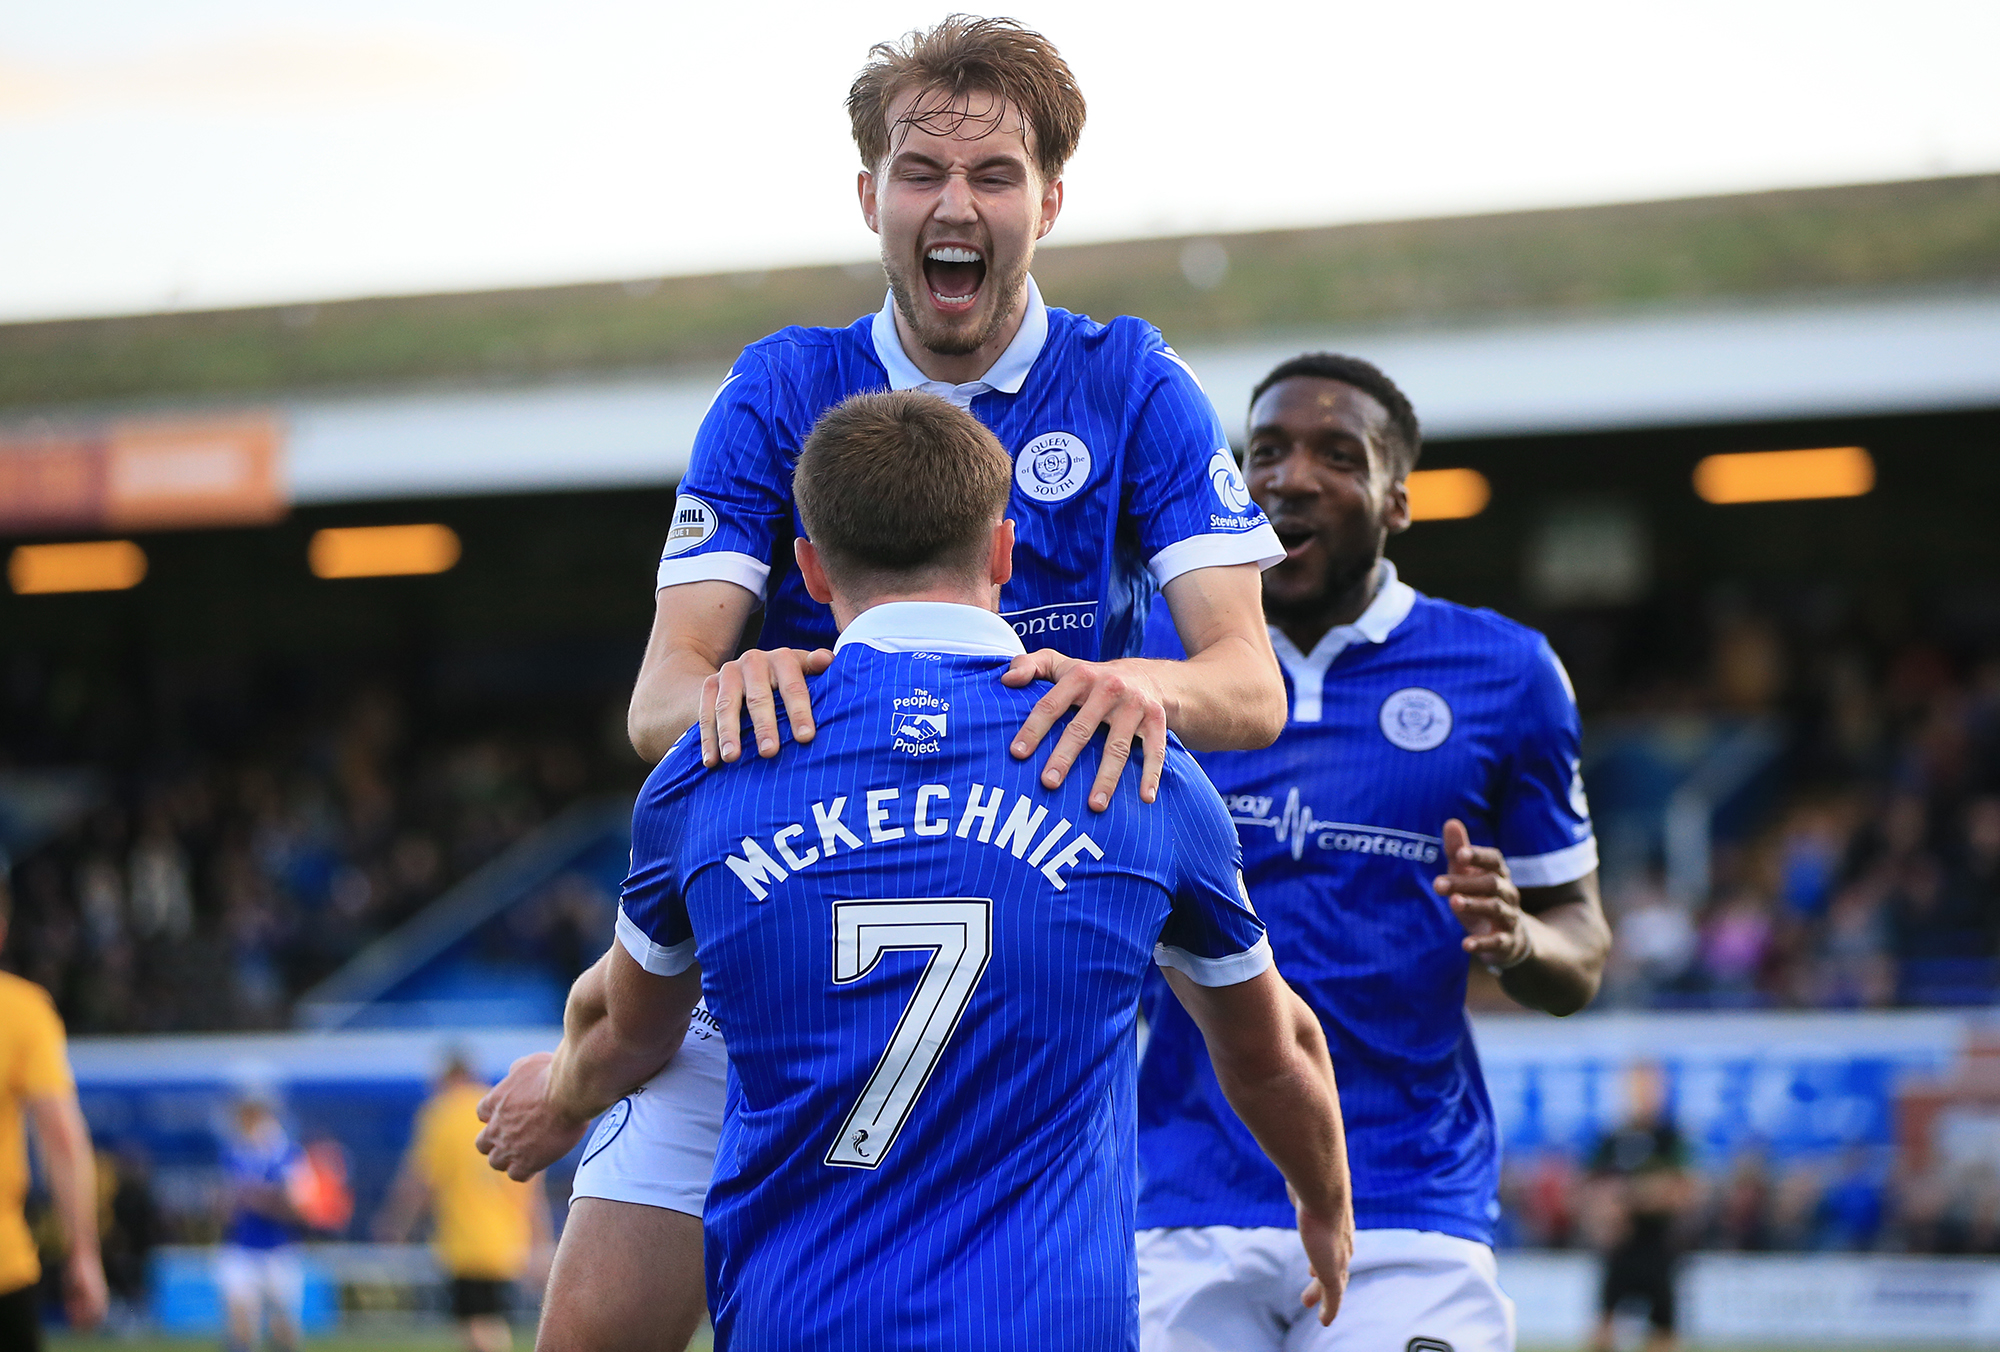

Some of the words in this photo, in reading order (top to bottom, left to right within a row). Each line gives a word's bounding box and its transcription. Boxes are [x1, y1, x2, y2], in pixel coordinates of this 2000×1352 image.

[1030, 437, 1070, 454] QUEEN
[1021, 466, 1030, 474] of
[1073, 455, 1085, 464] the
[1033, 478, 1075, 496] SOUTH
[679, 509, 705, 523] HILL
[1210, 513, 1238, 528] Stevie
[685, 528, 690, 536] 1
[914, 688, 928, 696] The
[893, 694, 950, 712] People's
[893, 738, 940, 757] Project
[824, 897, 994, 1170] 7
